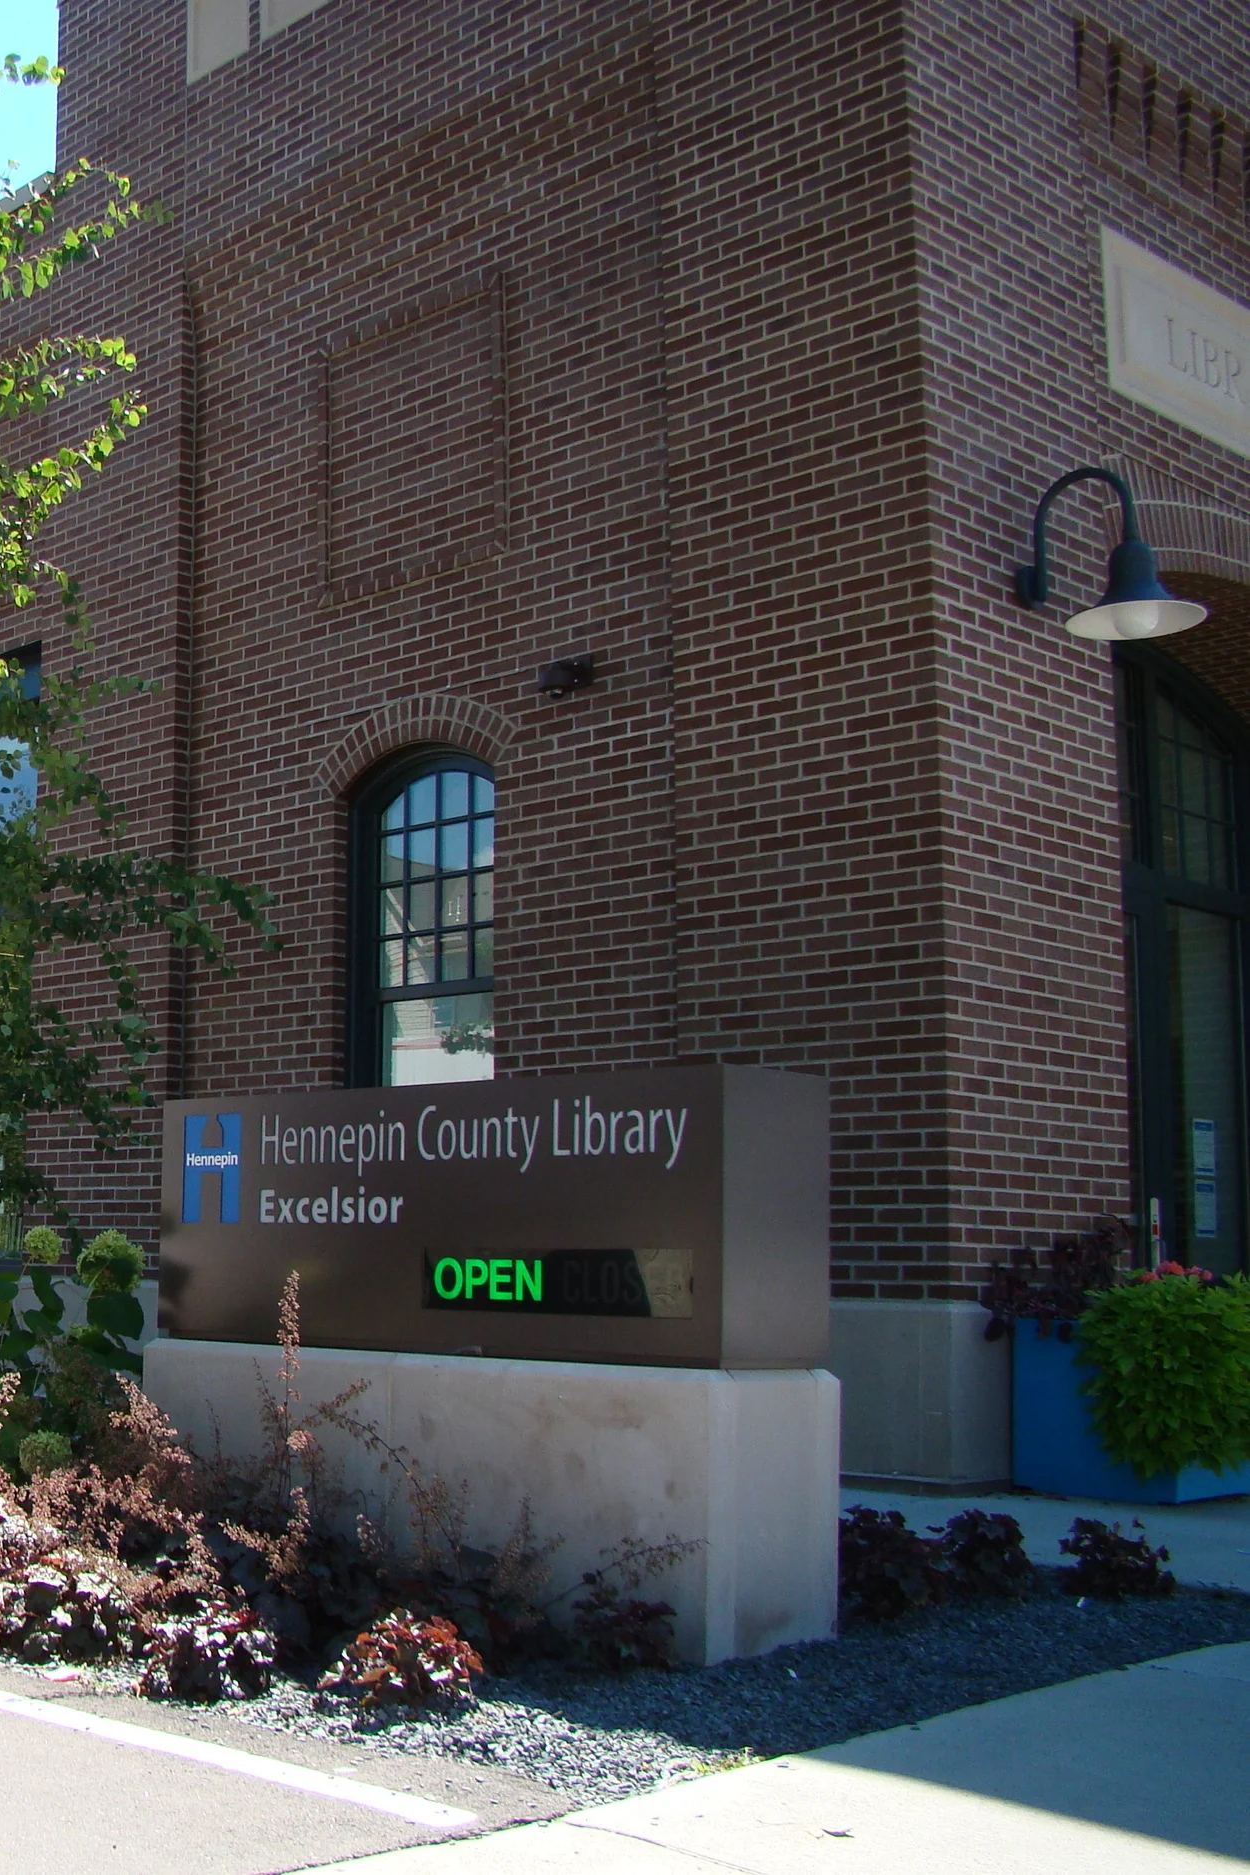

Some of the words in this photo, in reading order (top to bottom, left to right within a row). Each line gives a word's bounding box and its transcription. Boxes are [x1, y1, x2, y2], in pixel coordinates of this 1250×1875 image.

[261, 1110, 405, 1177] Hennepin
[417, 1103, 540, 1173] County
[552, 1095, 688, 1170] Library
[186, 1152, 239, 1169] Hennepin
[260, 1186, 403, 1224] Excelsior
[434, 1258, 543, 1302] OPEN
